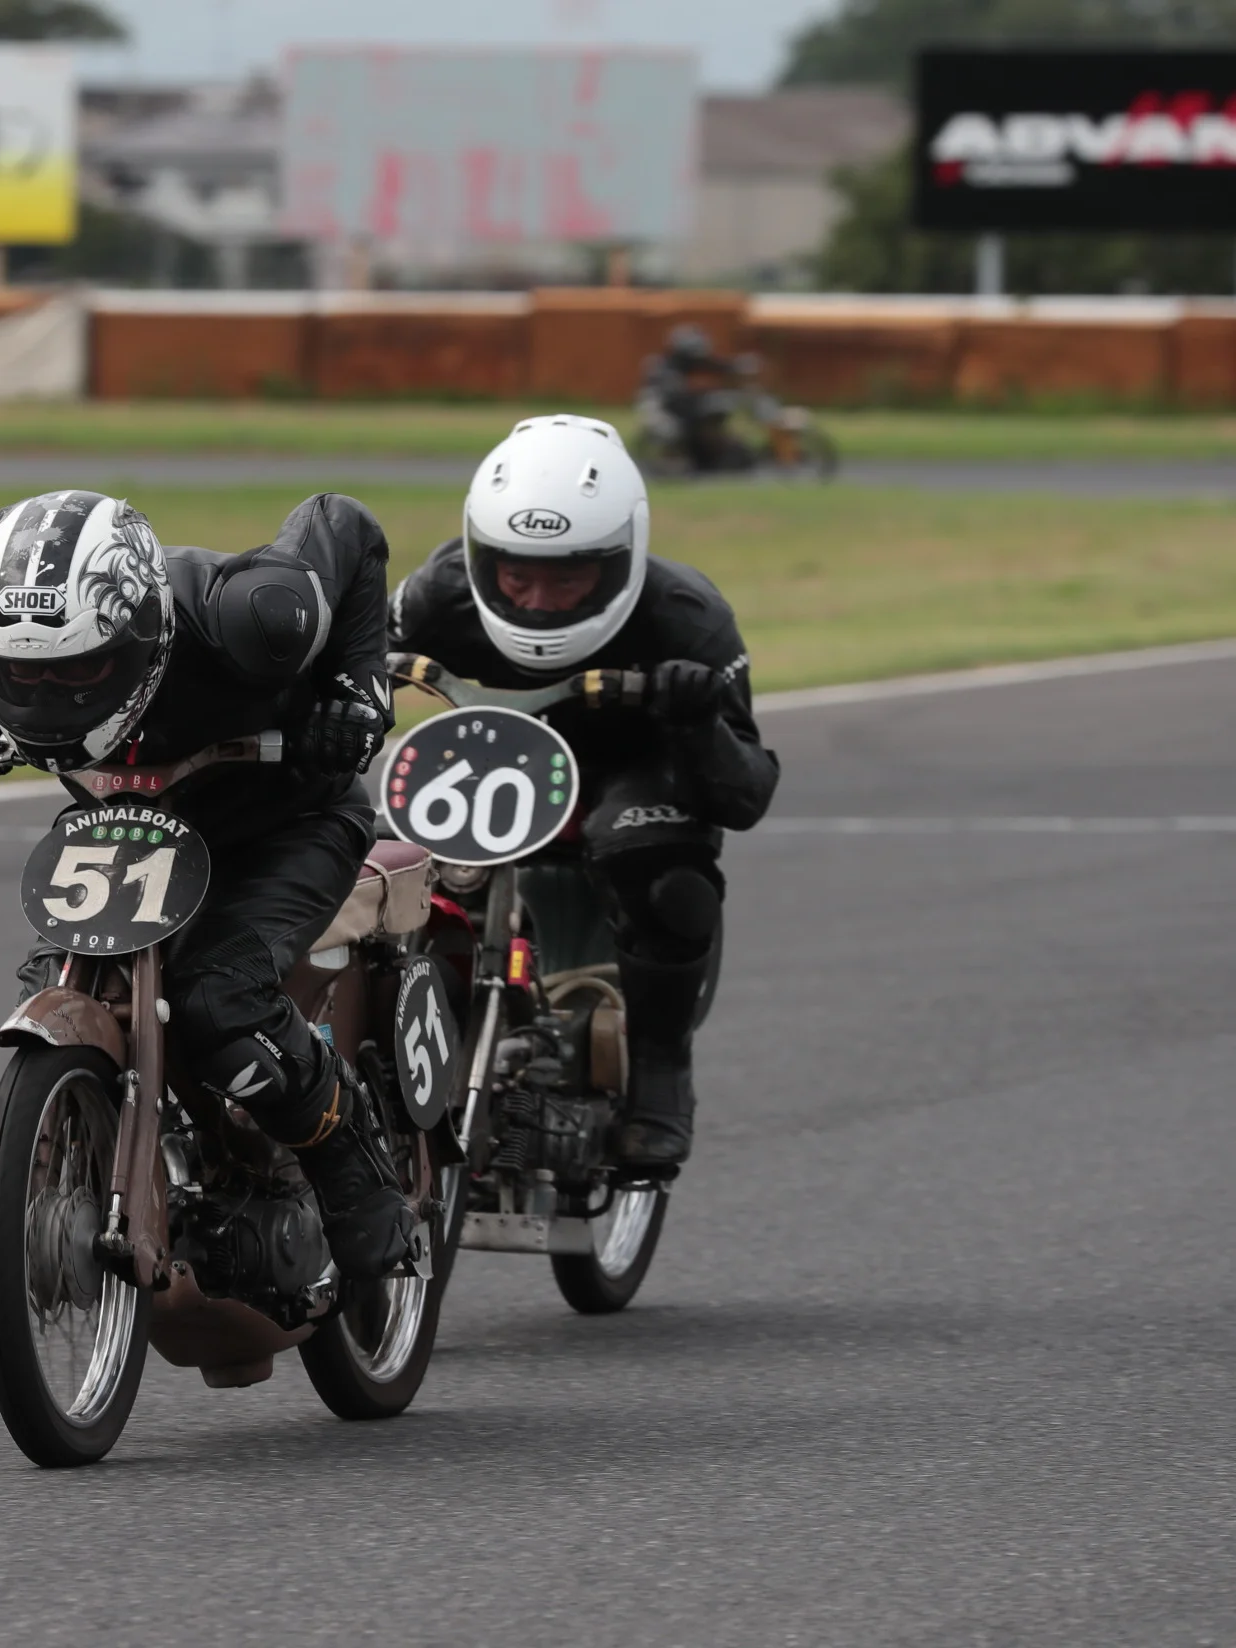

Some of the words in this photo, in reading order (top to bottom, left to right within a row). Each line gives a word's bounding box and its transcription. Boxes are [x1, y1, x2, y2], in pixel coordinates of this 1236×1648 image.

[510, 511, 562, 530] Arai
[4, 592, 56, 610] SHOEI
[65, 807, 190, 839] ANIMALBOAT
[409, 758, 535, 853] 60
[42, 845, 176, 922] 51
[397, 961, 431, 1031] ANIMALBOAT
[254, 1030, 284, 1060] TAICHI
[404, 984, 449, 1106] 51
